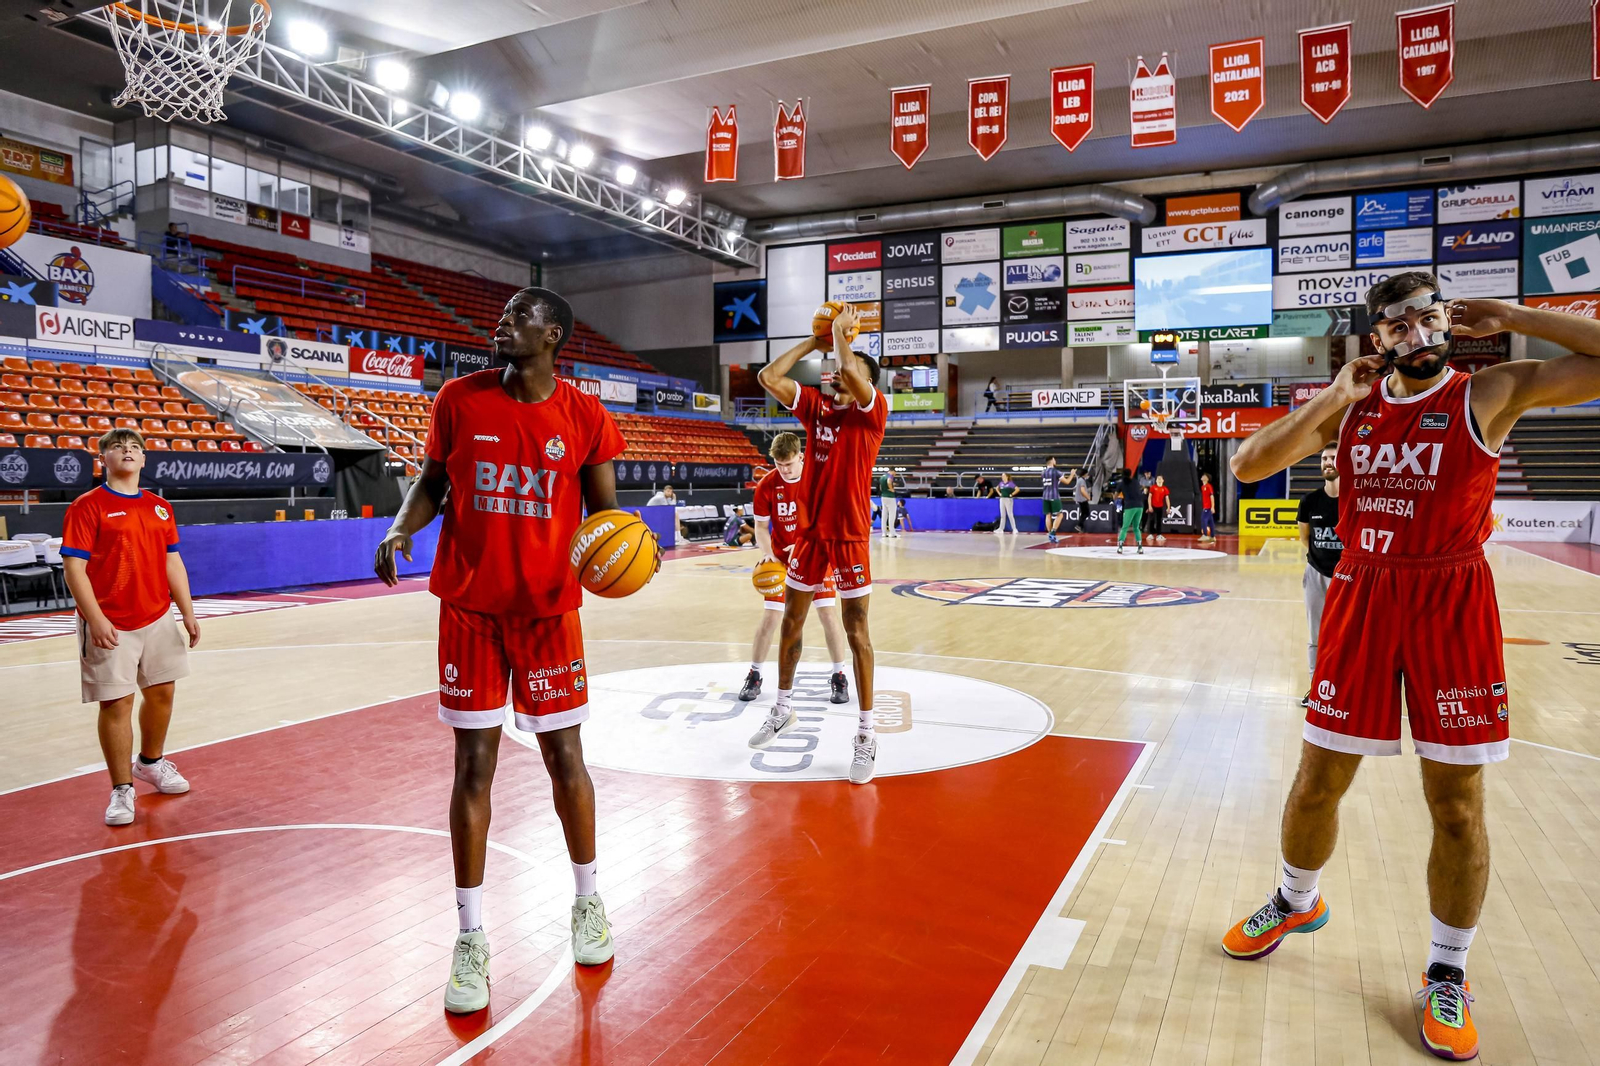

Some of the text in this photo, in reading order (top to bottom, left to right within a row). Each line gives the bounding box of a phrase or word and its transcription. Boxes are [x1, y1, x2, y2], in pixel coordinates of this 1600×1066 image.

[1411, 25, 1440, 42] LLIGA
[1311, 43, 1339, 58] LLIGA
[1403, 40, 1448, 59] CATALANA
[1223, 54, 1250, 68] LLIGA
[1315, 59, 1336, 74] ACB
[1213, 67, 1261, 84] CATALANA
[1416, 65, 1436, 77] 1997
[1057, 78, 1086, 93] LLIGA
[978, 92, 999, 104] COPA
[1062, 96, 1081, 109] LEB
[1224, 89, 1250, 103] 2021
[899, 101, 920, 113] LLIGA
[974, 106, 1002, 118] DEL REI
[894, 114, 926, 128] CATALANA
[1054, 112, 1089, 125] 2006-07
[1541, 187, 1595, 199] VITAM
[1167, 205, 1240, 217] www.gctplus.com
[1285, 207, 1345, 220] canonge
[1068, 224, 1126, 235] Sagalés
[1159, 229, 1177, 238] teva
[1183, 225, 1254, 245] GCT plus
[1156, 238, 1171, 248] ETT
[1358, 234, 1384, 248] arfe
[1441, 230, 1515, 250] EXLAND
[842, 250, 877, 262] Occident
[886, 242, 934, 258] JOVIAT
[1545, 249, 1572, 266] FUB
[50, 266, 93, 286] BAXI
[1008, 265, 1042, 276] ALL IN
[1455, 266, 1515, 278] santasusana
[886, 276, 936, 290] sensus
[833, 292, 877, 301] PETROBAGES
[1298, 291, 1357, 306] sarsa
[62, 316, 132, 341] AIGNEP
[1208, 328, 1258, 339] CLARET
[178, 332, 224, 344] VOLVO
[1457, 339, 1493, 348] GRADA
[888, 342, 911, 350] sarsa
[290, 347, 345, 365] SCANIA
[450, 351, 489, 366] mecexis
[891, 354, 931, 366] BAR
[362, 350, 415, 378] Coca-Cola
[1052, 391, 1096, 404] AIGNEP
[1216, 411, 1236, 434] id
[1350, 442, 1444, 476] BAXI
[0, 463, 27, 472] BAXI
[55, 464, 80, 472] BAXI
[155, 460, 295, 480] BAXIMANRESA.COM
[314, 466, 330, 474] BAXI
[475, 460, 558, 499] BAXI
[478, 496, 548, 518] MANRESA
[1356, 496, 1414, 520] MANRESA
[1507, 518, 1582, 528] Kouten.cat
[570, 521, 616, 568] Wilson
[527, 664, 568, 680] Adbisio
[528, 678, 552, 692] ETL
[531, 688, 570, 702] GLOBAL
[1436, 686, 1487, 700] Adbisio
[875, 694, 903, 728] GROUP
[1438, 701, 1468, 716] ETL
[1440, 714, 1493, 729] GLOBAL
